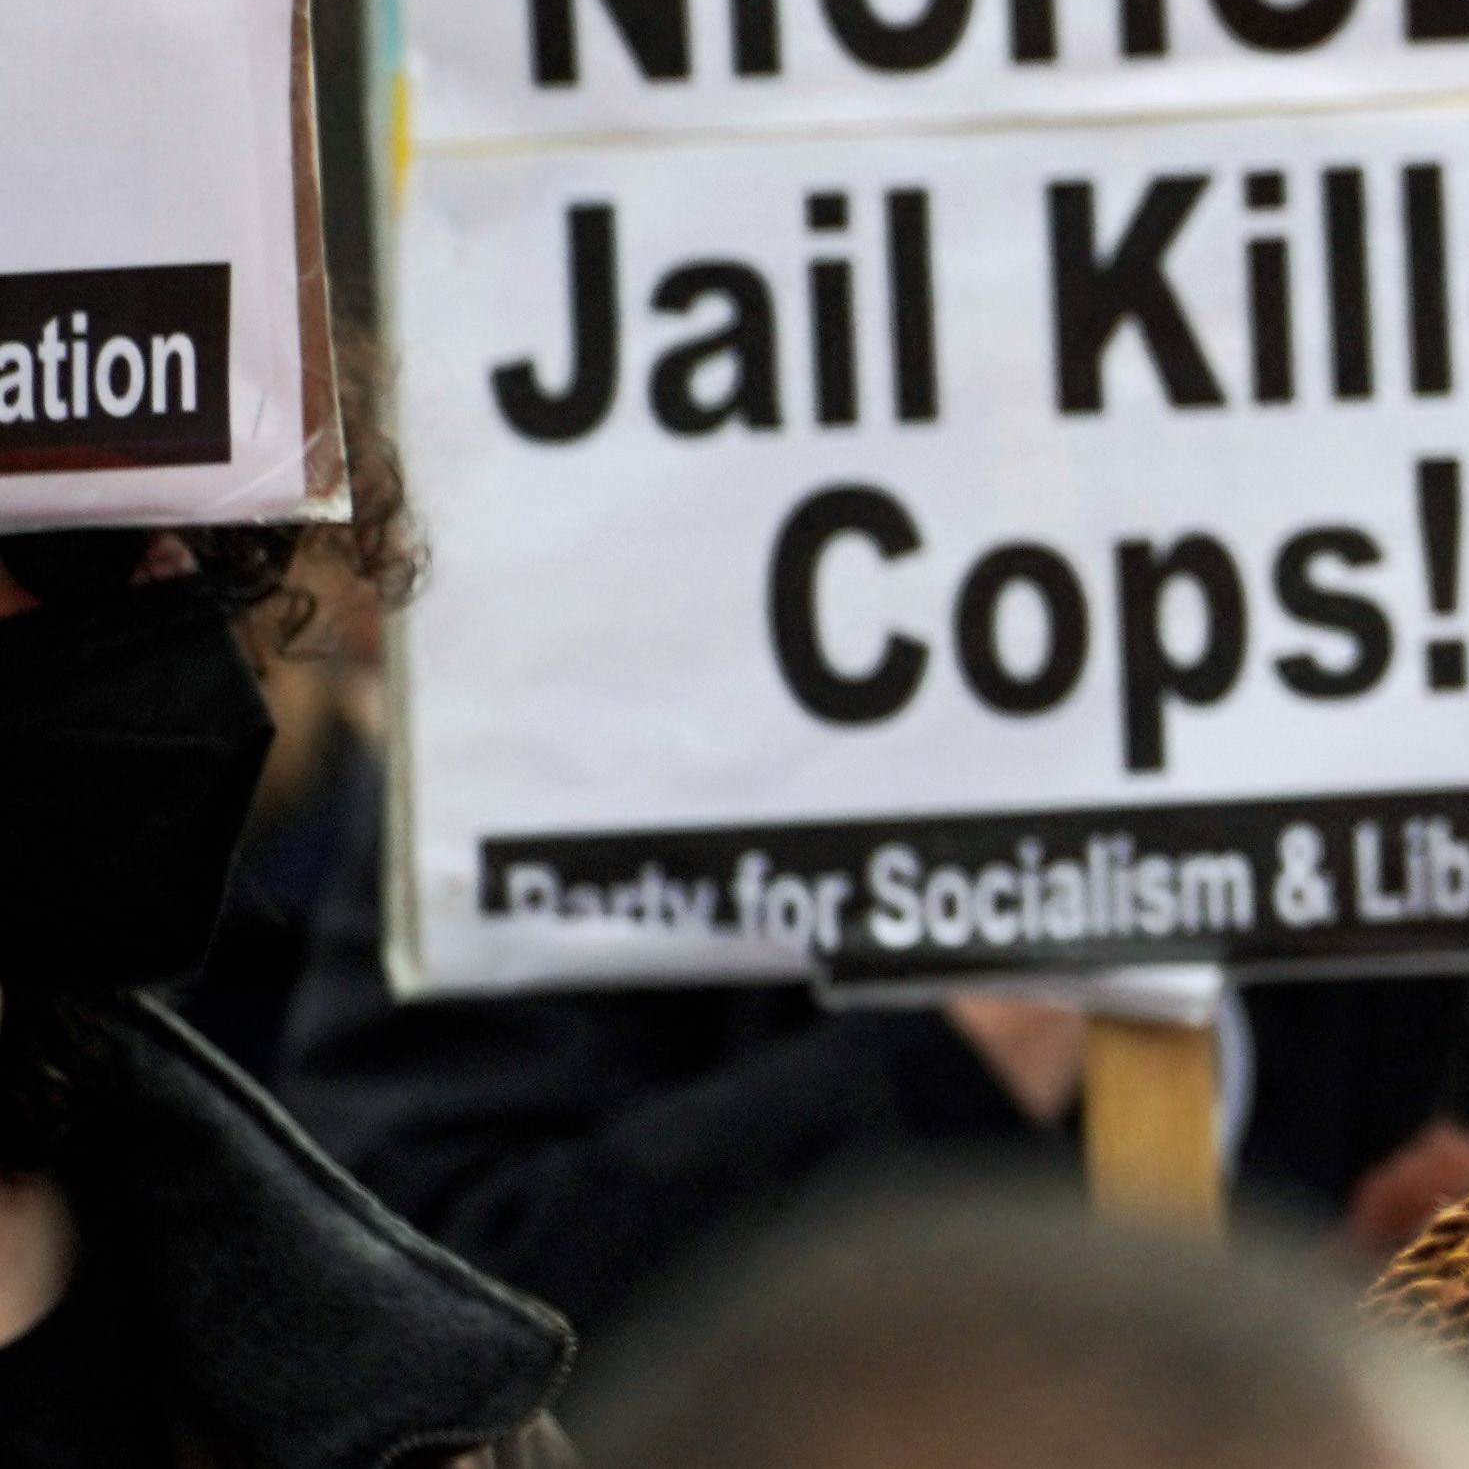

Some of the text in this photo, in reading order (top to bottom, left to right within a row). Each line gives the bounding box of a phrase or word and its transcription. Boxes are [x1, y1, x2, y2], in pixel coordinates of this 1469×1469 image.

[490, 189, 939, 445] Jail
[768, 456, 1469, 774] Cops!
[737, 848, 852, 952] for
[869, 835, 1252, 952] Socialism
[1275, 822, 1334, 927] &
